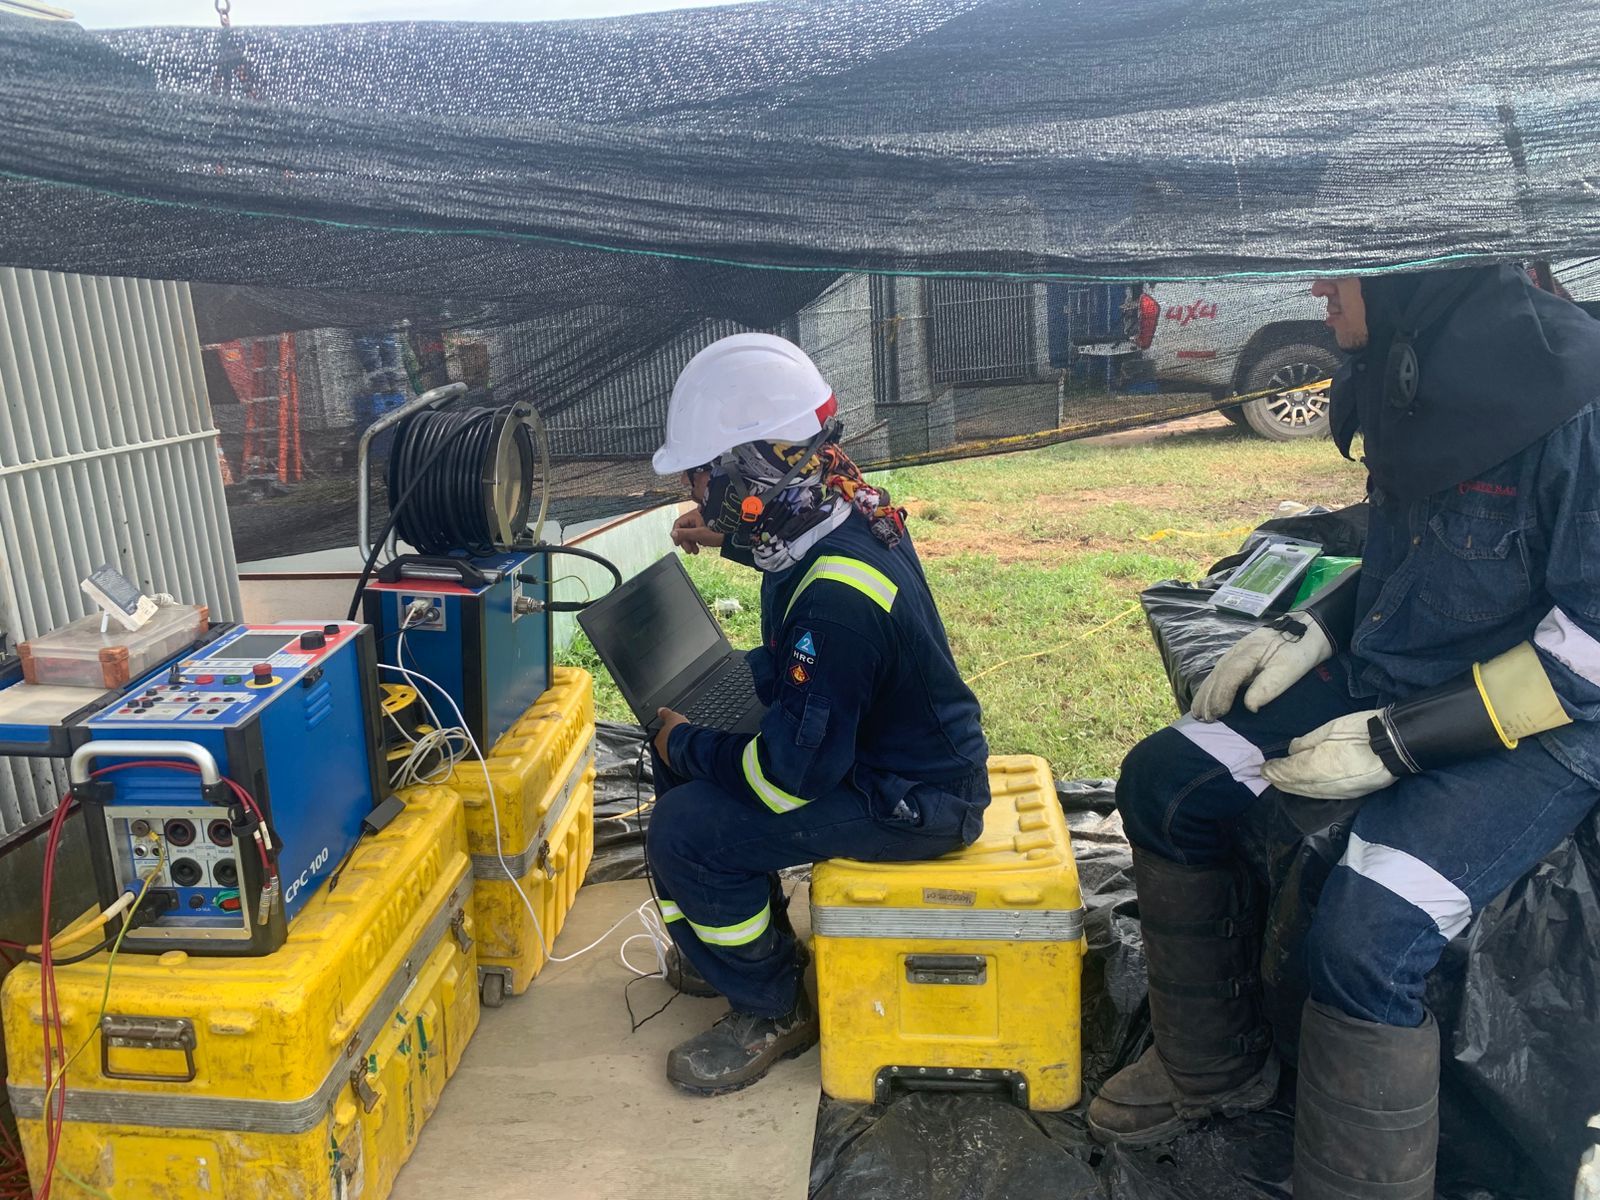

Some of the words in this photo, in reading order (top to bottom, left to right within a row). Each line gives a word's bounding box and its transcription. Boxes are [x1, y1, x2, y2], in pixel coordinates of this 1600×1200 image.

[802, 638, 810, 650] 2
[793, 650, 814, 664] HRC
[285, 869, 309, 904] CPC
[309, 847, 329, 875] 100
